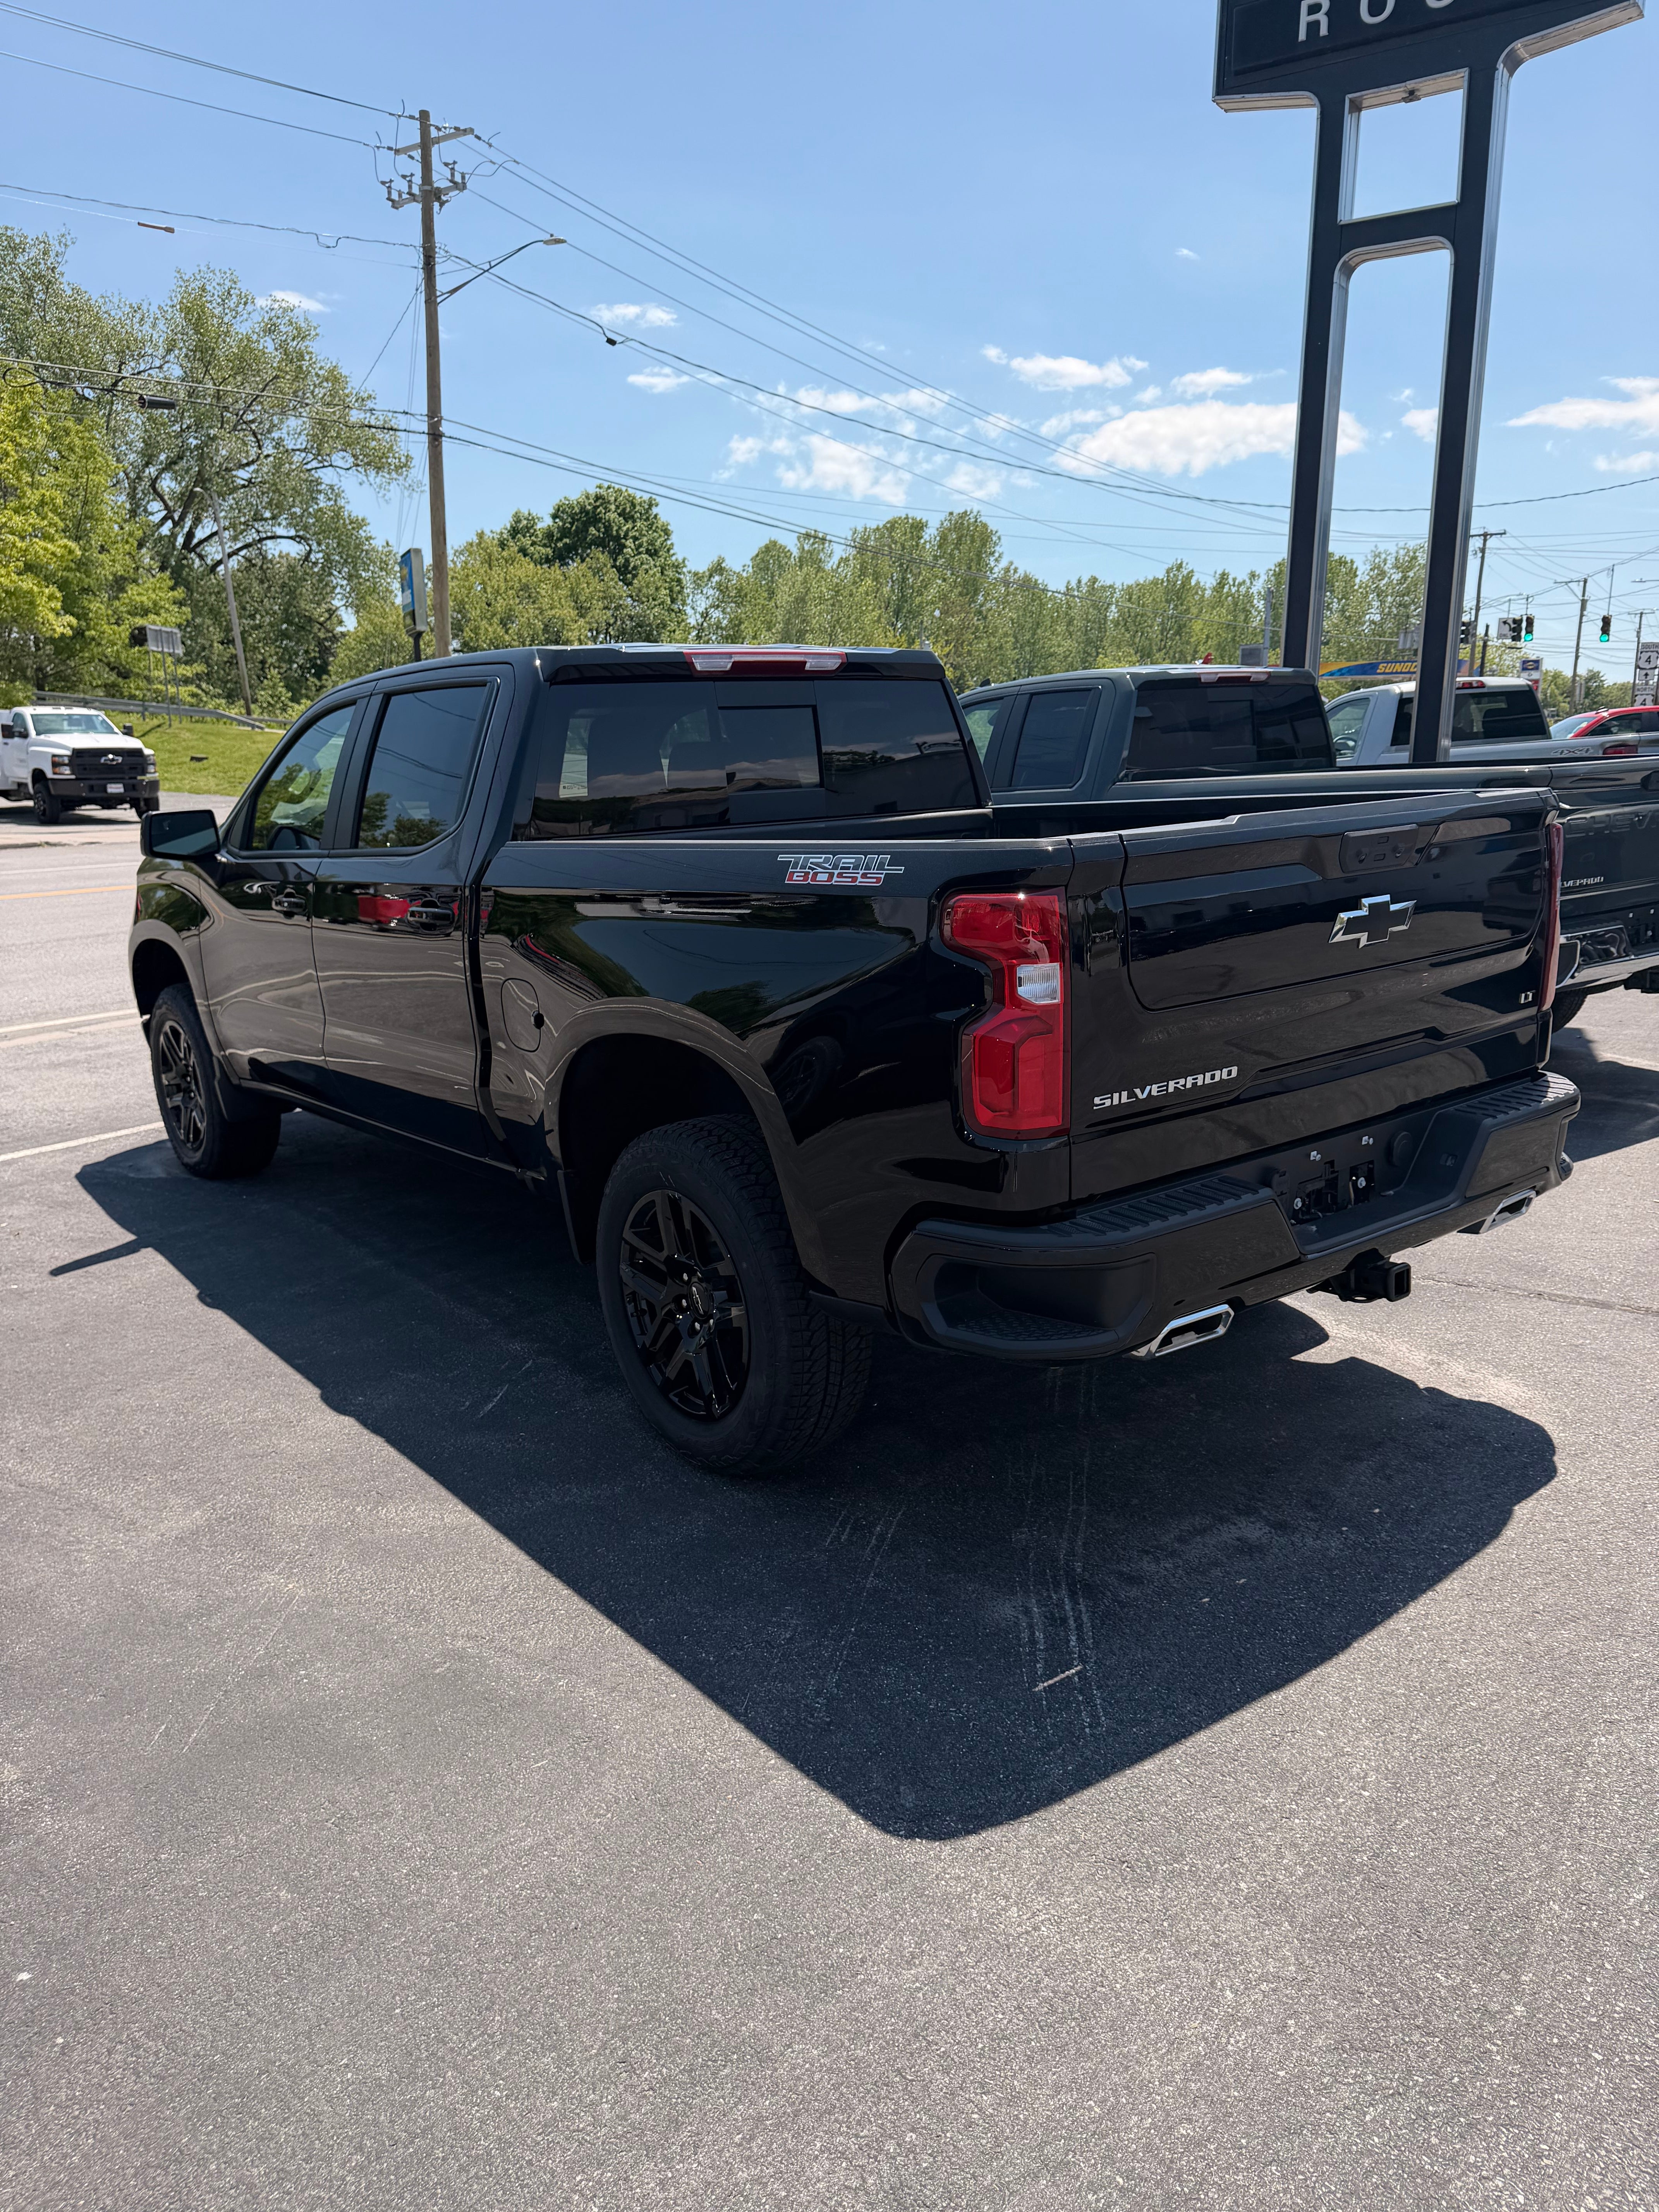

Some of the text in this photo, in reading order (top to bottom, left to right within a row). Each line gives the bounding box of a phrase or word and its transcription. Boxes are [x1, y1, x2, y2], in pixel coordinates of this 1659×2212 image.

[1644, 654, 1652, 665] 4
[1377, 662, 1418, 673] SUNOC
[1640, 698, 1647, 706] 4
[777, 855, 905, 873] TRAIL
[785, 870, 885, 886] BOSS
[1093, 1066, 1238, 1109] SILVERADO
